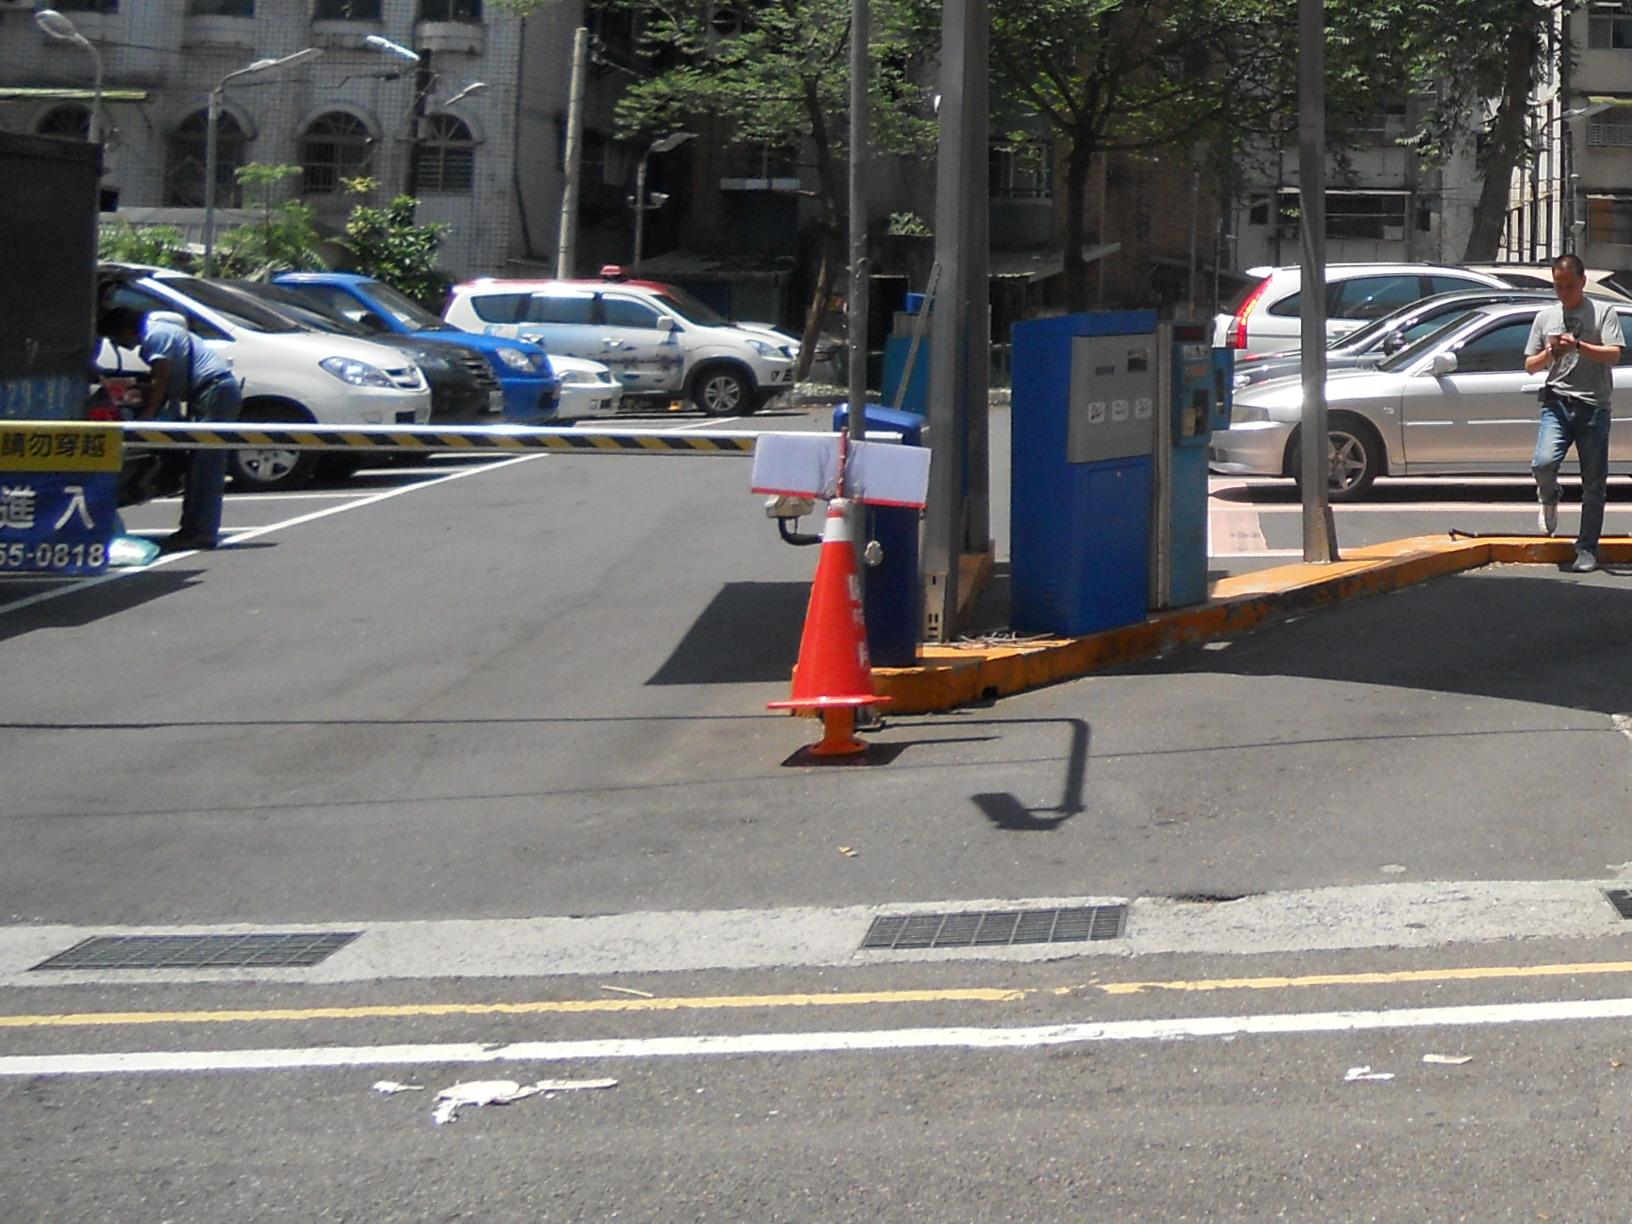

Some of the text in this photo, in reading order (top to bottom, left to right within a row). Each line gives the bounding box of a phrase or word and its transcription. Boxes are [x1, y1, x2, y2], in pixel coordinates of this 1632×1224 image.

[2, 432, 106, 457] 請勿穿越
[0, 485, 95, 530] 進入
